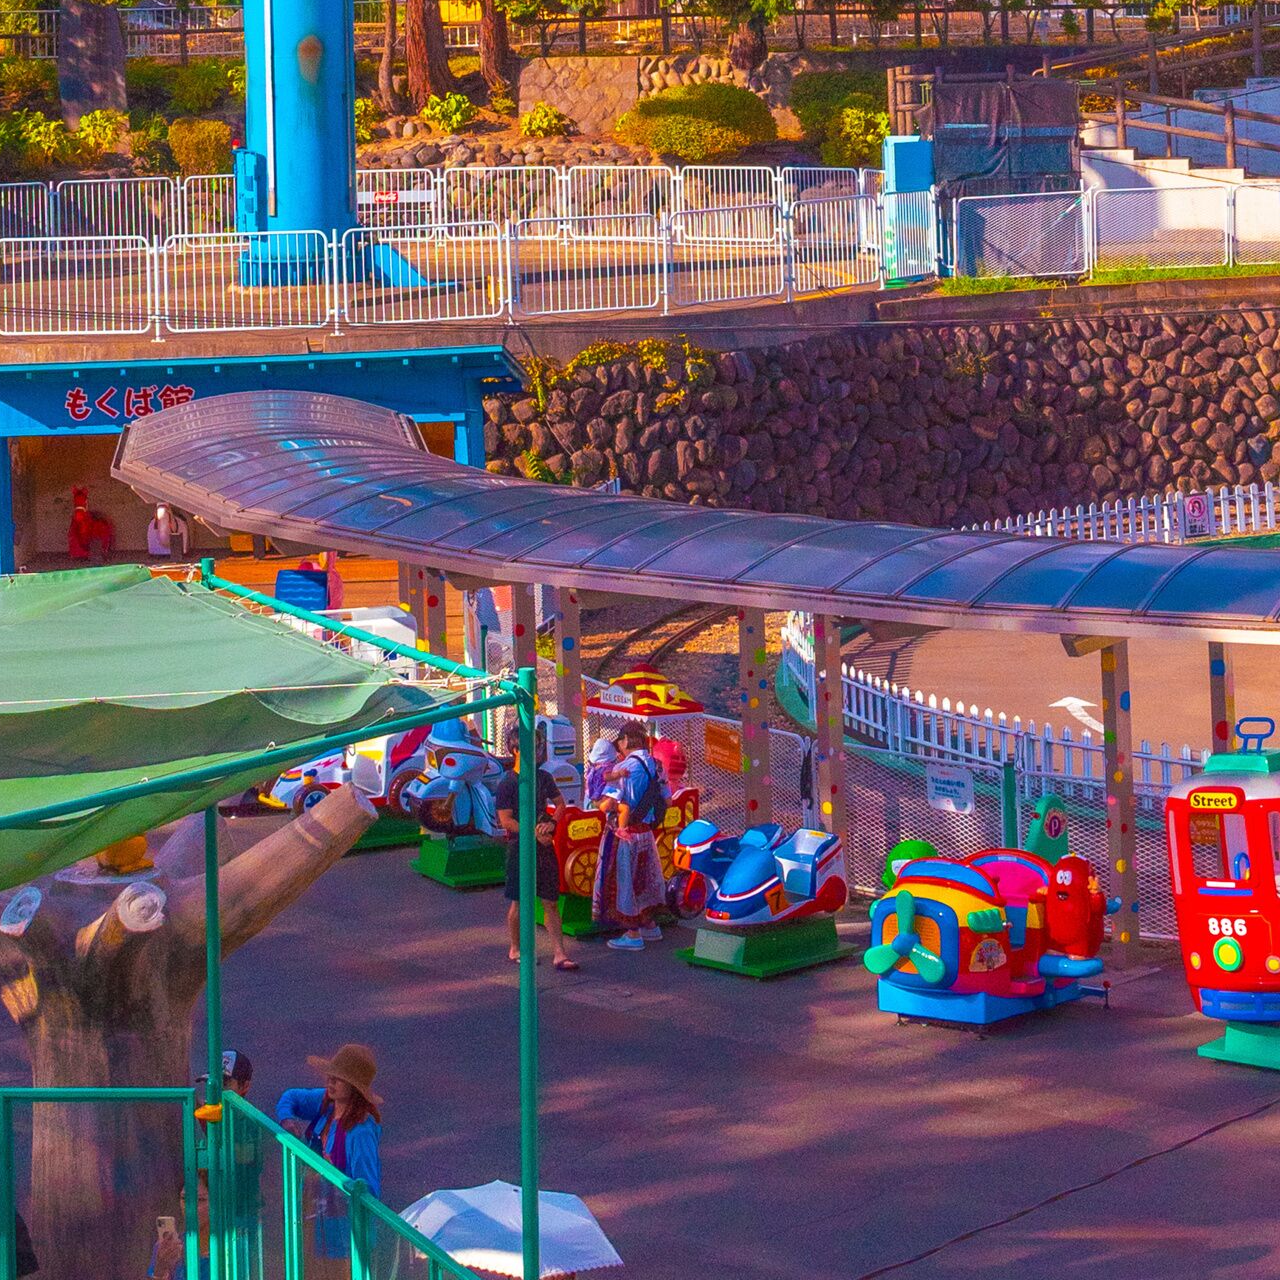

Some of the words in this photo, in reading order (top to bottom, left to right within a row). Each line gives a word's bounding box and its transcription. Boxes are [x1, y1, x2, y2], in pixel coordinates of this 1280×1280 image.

[64, 384, 195, 421] もくば館
[602, 692, 613, 703] ICE
[613, 694, 632, 705] CREAM
[1192, 794, 1234, 807] Street
[676, 848, 687, 865] 7
[771, 891, 782, 911] 7
[1208, 917, 1247, 936] 886
